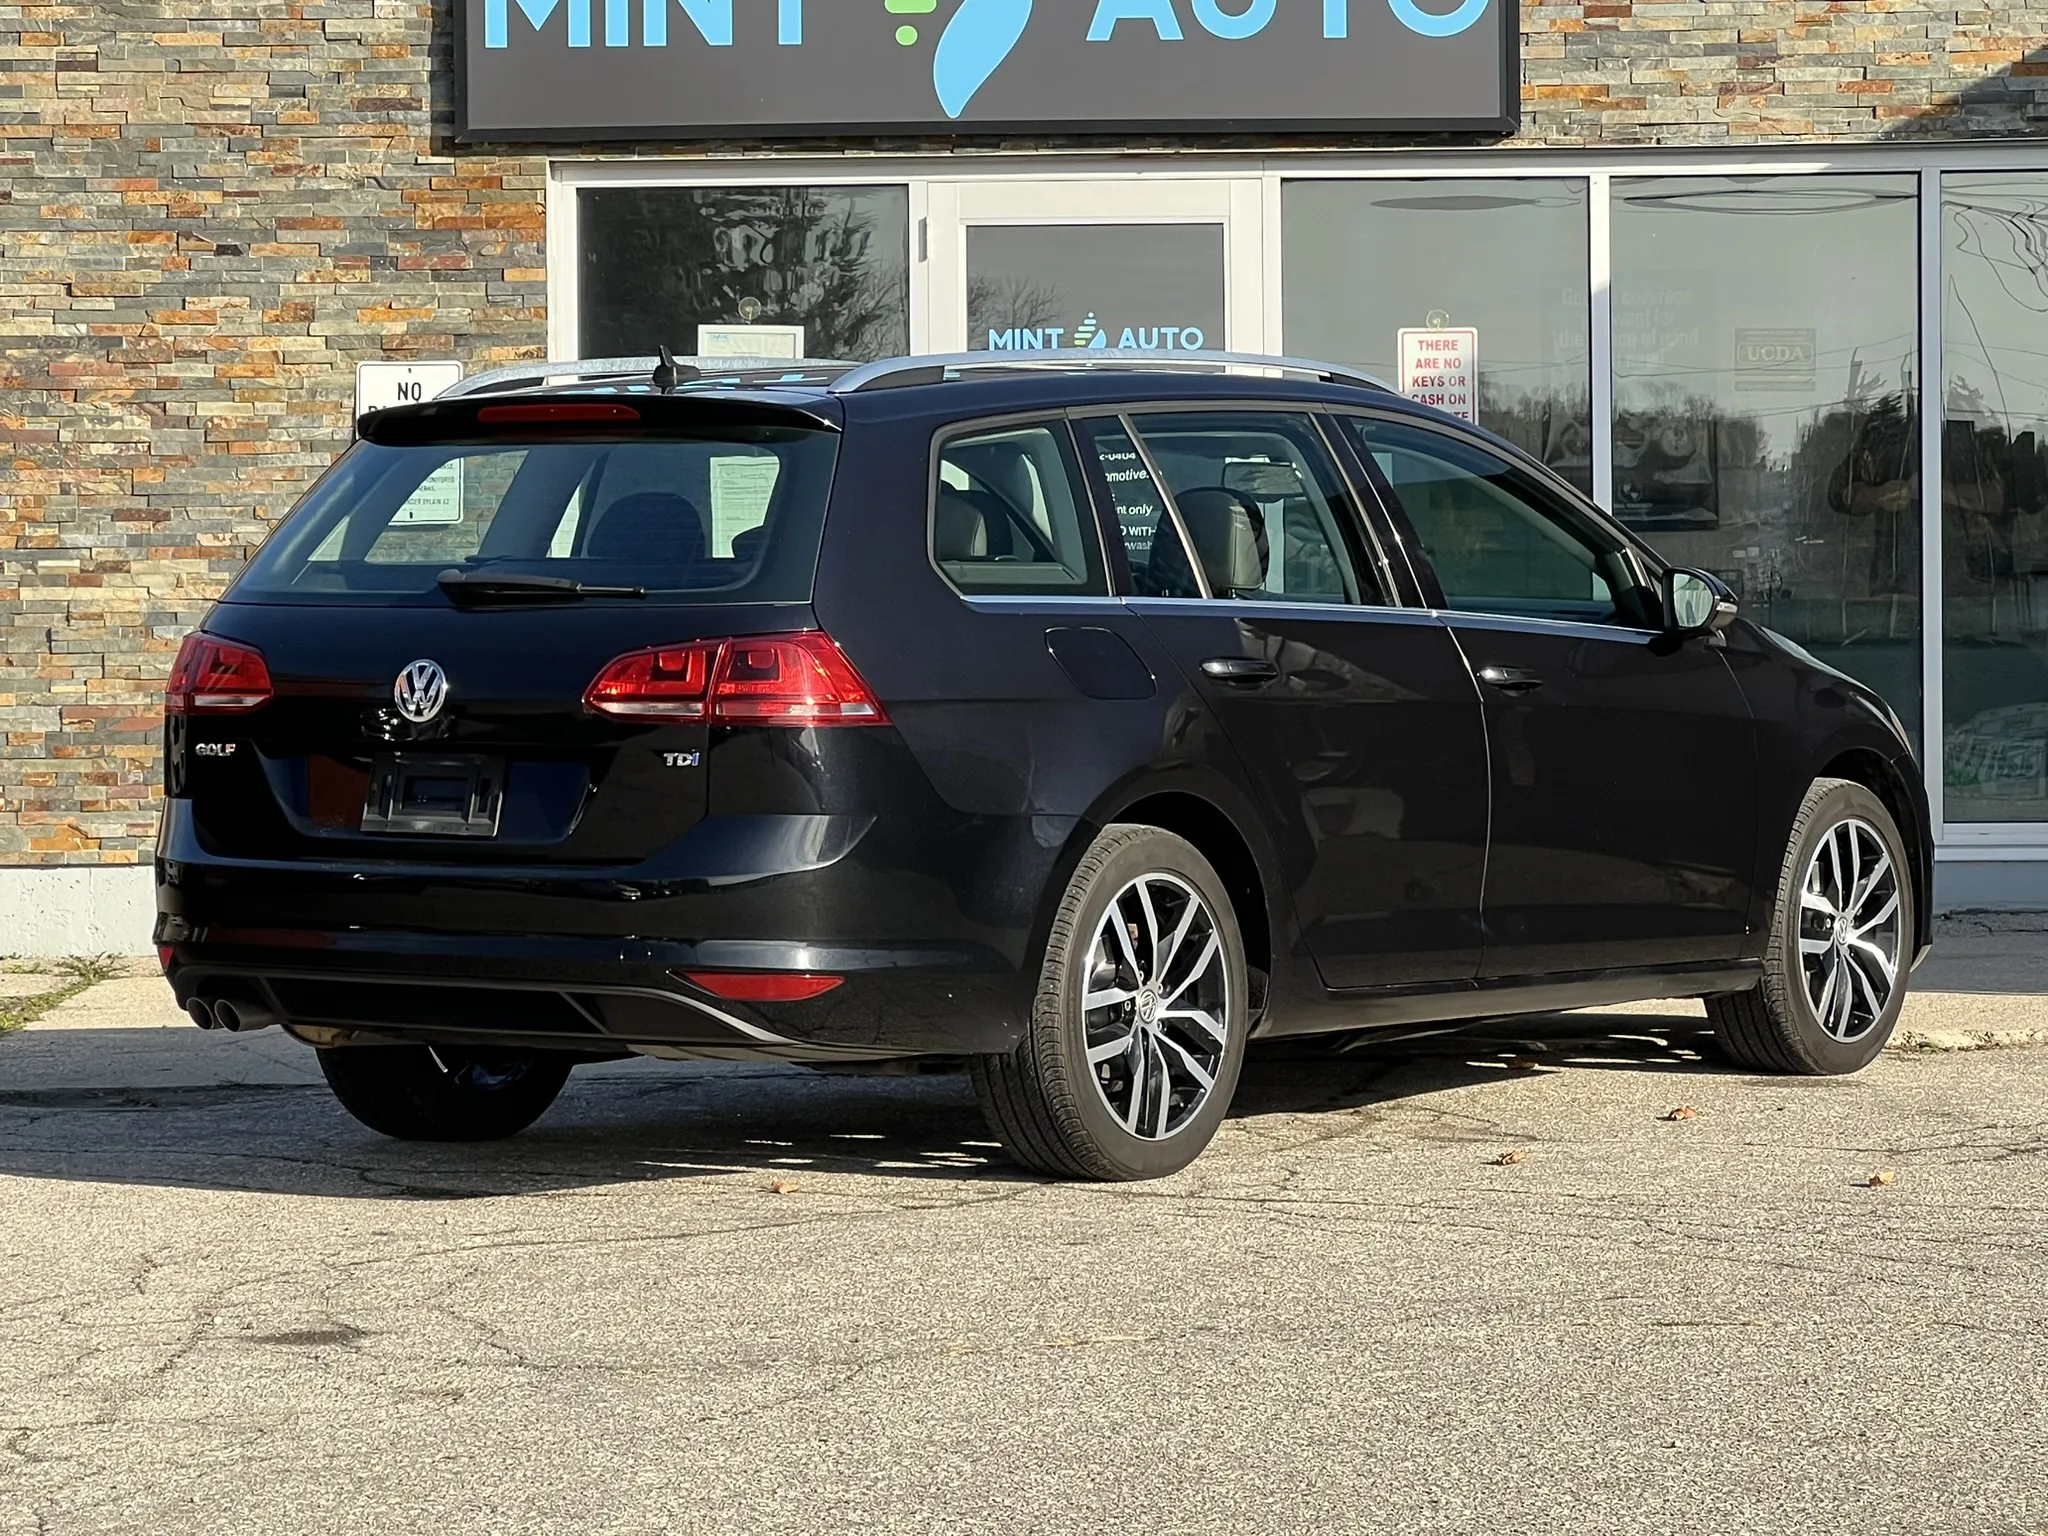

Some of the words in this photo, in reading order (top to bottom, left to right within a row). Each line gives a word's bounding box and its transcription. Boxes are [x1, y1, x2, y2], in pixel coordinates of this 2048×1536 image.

[988, 328, 1064, 350] MINT
[1118, 327, 1204, 350] AUTO
[1418, 339, 1459, 351] THERE
[1746, 345, 1804, 361] UCDA
[1415, 358, 1440, 369] ARE
[1443, 358, 1462, 369] NO
[1412, 376, 1445, 387] KEYS
[1448, 375, 1466, 387] OR
[397, 382, 422, 402] NO
[1411, 393, 1445, 405] CASH
[1448, 393, 1467, 405] ON
[1128, 503, 1154, 517] only
[195, 743, 236, 756] GOLF
